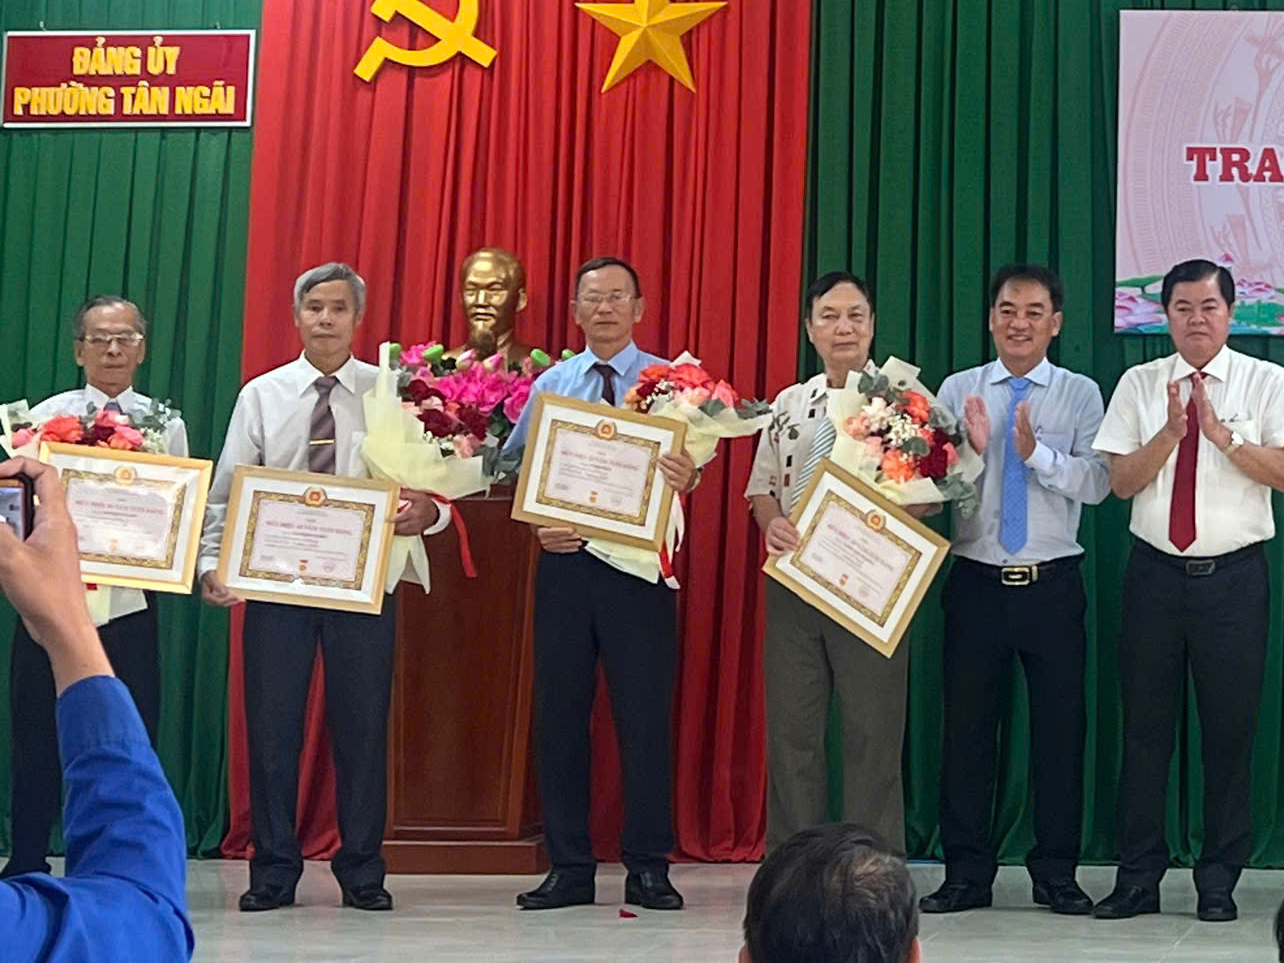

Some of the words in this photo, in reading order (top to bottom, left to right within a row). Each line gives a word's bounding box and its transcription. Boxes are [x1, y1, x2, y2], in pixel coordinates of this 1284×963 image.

[72, 35, 142, 75] ĐẢNG
[146, 35, 181, 75] ỦY
[13, 80, 115, 116] PHƯỜNG
[120, 80, 170, 115] TÂN
[174, 80, 236, 115] NGÃI
